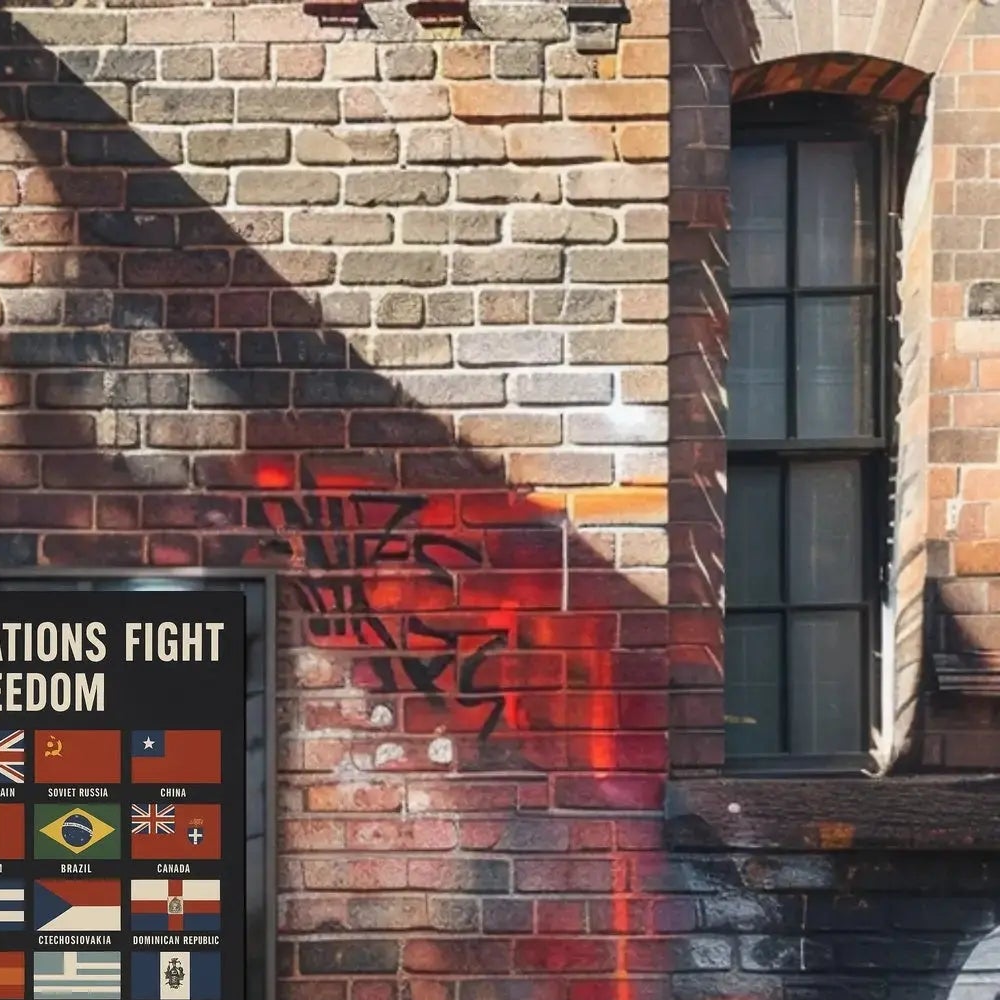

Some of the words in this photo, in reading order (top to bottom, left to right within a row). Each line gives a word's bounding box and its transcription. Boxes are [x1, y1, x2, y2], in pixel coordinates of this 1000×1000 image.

[125, 621, 225, 662] FIGHT
[47, 787, 77, 798] SOVIET
[79, 787, 109, 798] RUSSIA
[160, 787, 187, 798] CHINA
[60, 863, 92, 874] BRAZIL
[156, 863, 191, 874] CANADA
[132, 935, 180, 945] DOMINICAN
[183, 935, 220, 945] REPUBLIC
